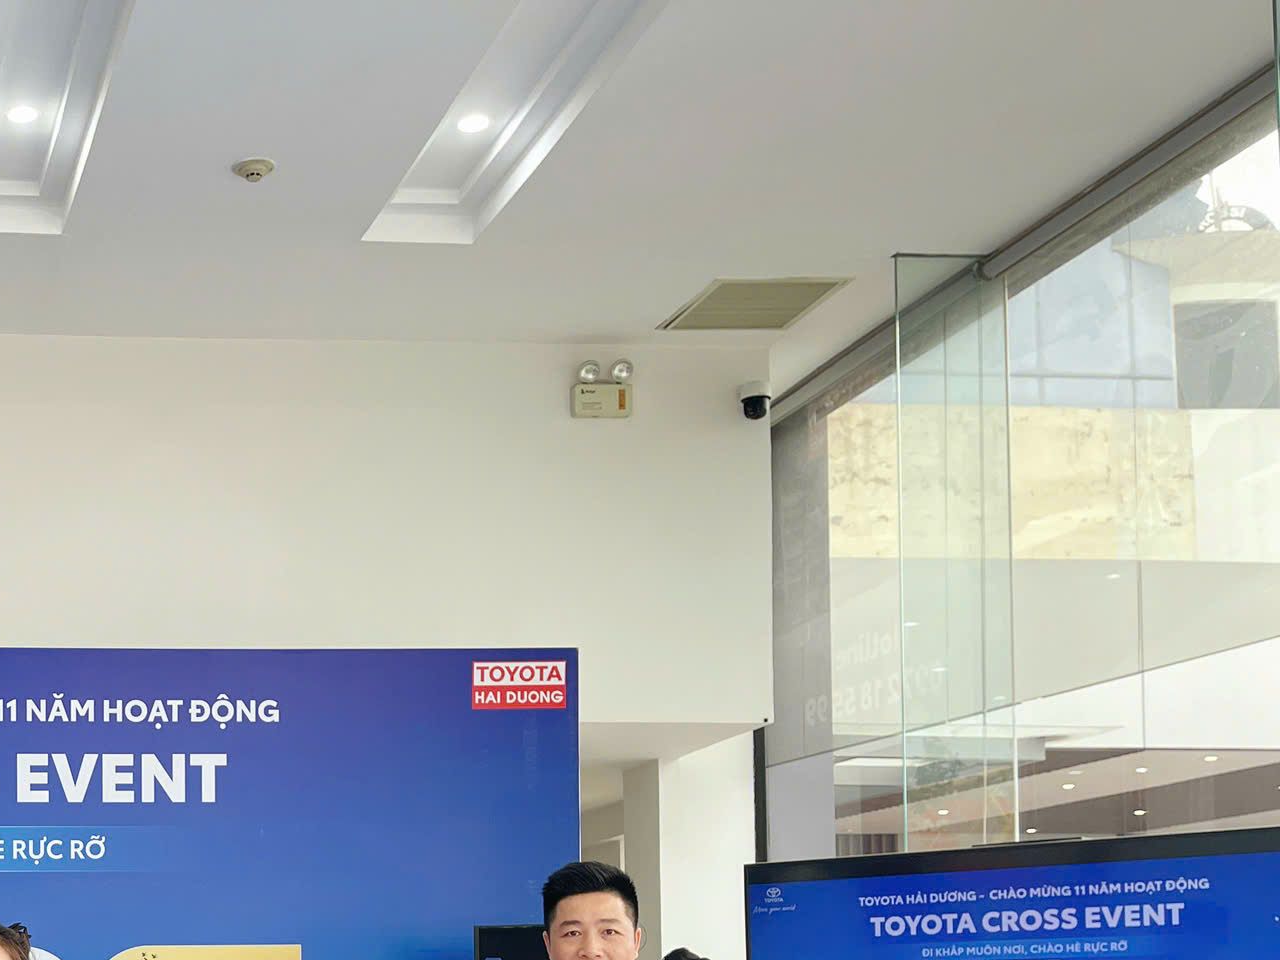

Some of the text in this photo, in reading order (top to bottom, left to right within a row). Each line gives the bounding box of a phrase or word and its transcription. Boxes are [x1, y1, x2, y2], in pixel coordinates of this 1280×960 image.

[476, 665, 563, 682] TOYOTA
[26, 693, 95, 722] NĂM
[103, 699, 183, 730] HOẠT
[189, 693, 280, 730] ĐỘNG
[475, 690, 564, 704] HAI DUONG
[16, 753, 228, 803] EVENT
[12, 836, 63, 865] RỰC
[70, 835, 106, 860] RỠ
[859, 895, 904, 907] TOYOTA
[906, 891, 927, 905] HẢI
[930, 891, 977, 904] DƯƠNG
[989, 886, 1027, 900] CHÀO
[1030, 885, 1072, 898] MỪNG
[1074, 885, 1086, 896] 11
[1089, 881, 1121, 895] NĂM
[1124, 880, 1162, 896] HOẠT
[1165, 877, 1210, 893] ĐỘNG
[869, 902, 1185, 937] TOYOTA CROSS EVENT
[922, 948, 933, 958] ĐI
[967, 944, 1001, 956] MUÔN
[1030, 942, 1063, 954] CHÀO
[1066, 941, 1081, 952] HÈ
[1084, 942, 1108, 954] RỰC
